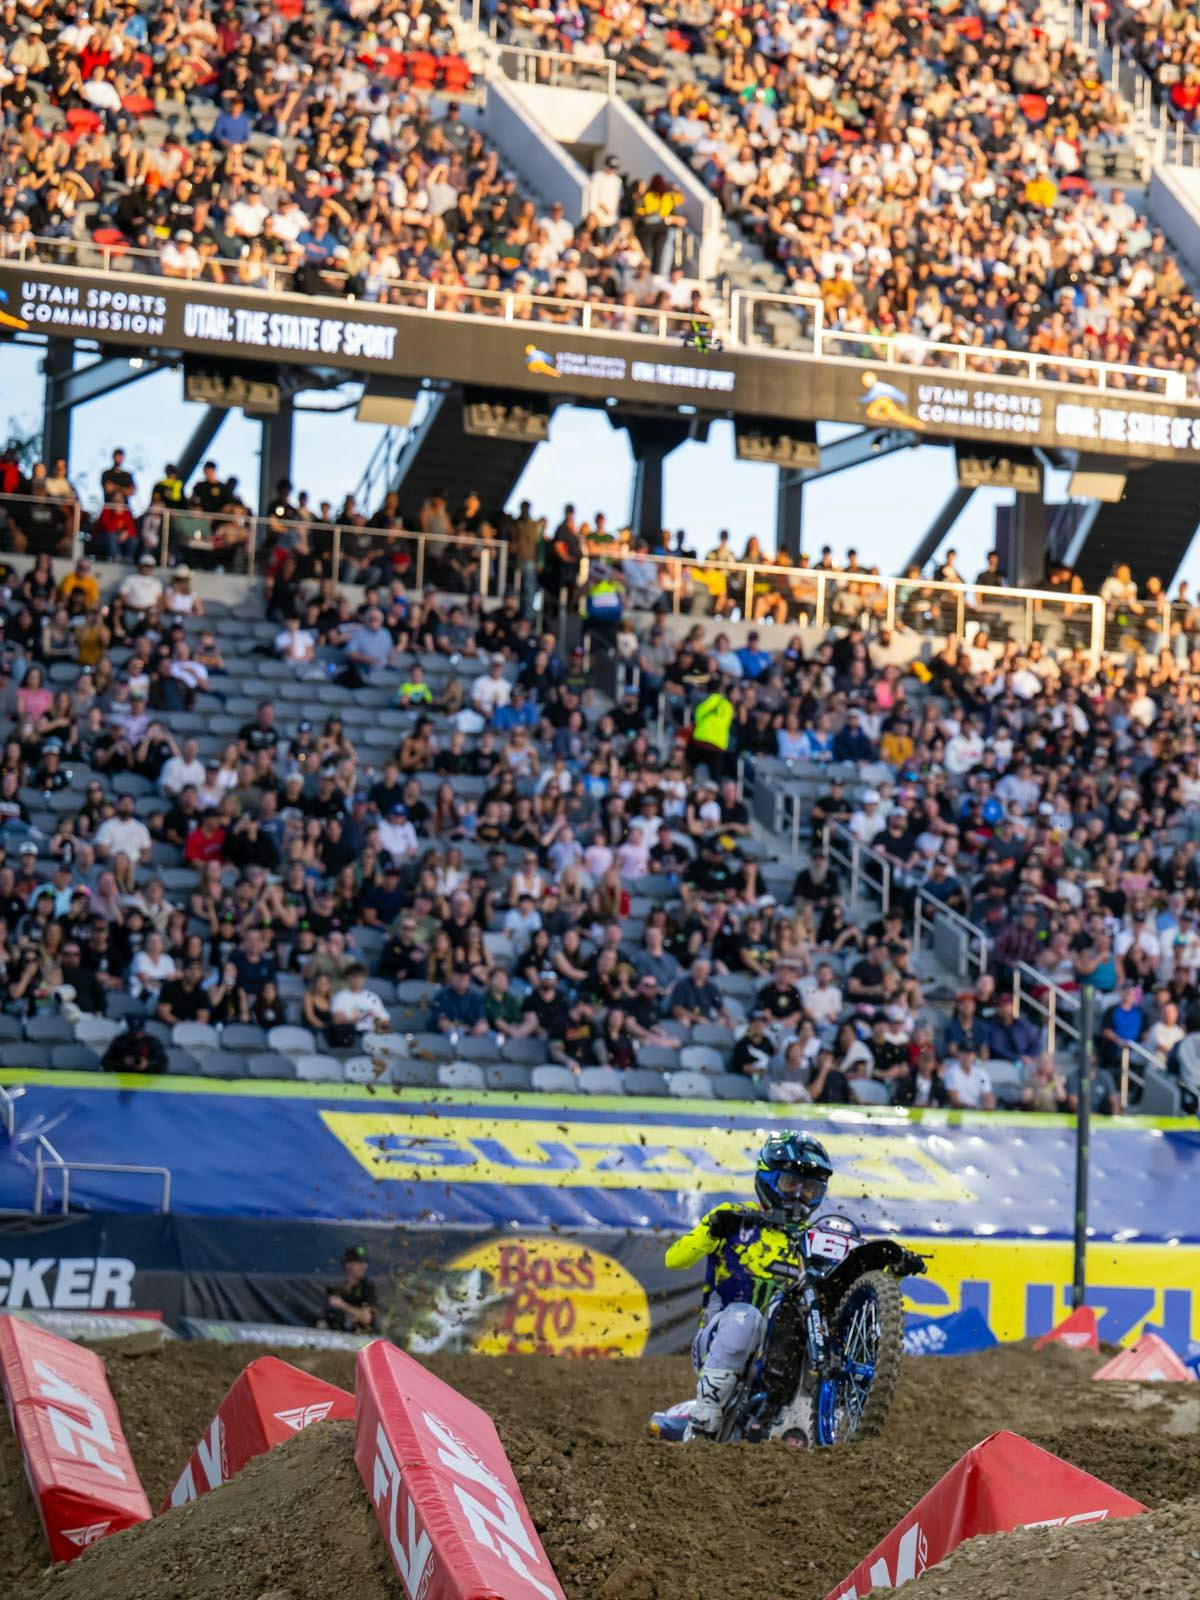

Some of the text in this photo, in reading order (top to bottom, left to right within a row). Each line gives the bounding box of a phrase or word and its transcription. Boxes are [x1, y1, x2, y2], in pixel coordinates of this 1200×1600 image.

[20, 302, 164, 335] COMMISSION
[22, 281, 166, 315] UTAH SPORTS
[184, 303, 398, 360] UTAH: THE STATE OF SPORT
[917, 403, 1040, 432] COMMISSION
[918, 384, 1041, 415] UTAH SPORTS
[1127, 411, 1171, 447] STATE
[1171, 417, 1192, 449] OF
[0, 1257, 136, 1309] KER
[499, 1246, 596, 1290] Bass
[504, 1283, 576, 1342] Pro
[32, 1359, 127, 1482] FLY
